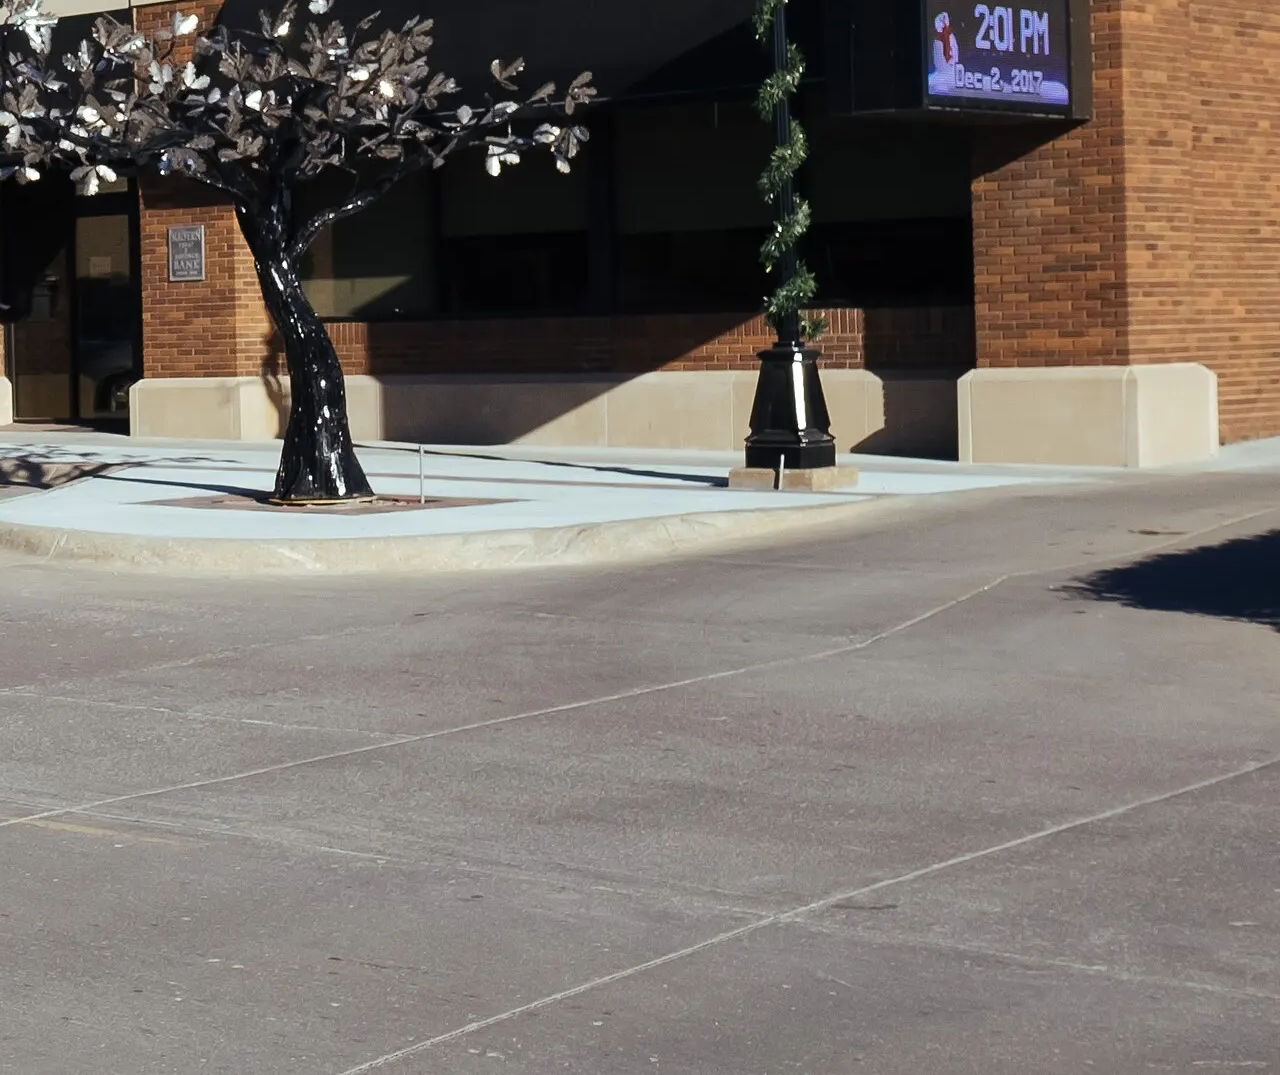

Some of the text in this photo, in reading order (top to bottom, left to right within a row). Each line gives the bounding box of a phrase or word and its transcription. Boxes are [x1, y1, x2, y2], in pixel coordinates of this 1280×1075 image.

[974, 3, 1049, 55] 2:01 PM
[1010, 69, 1043, 94] 2017
